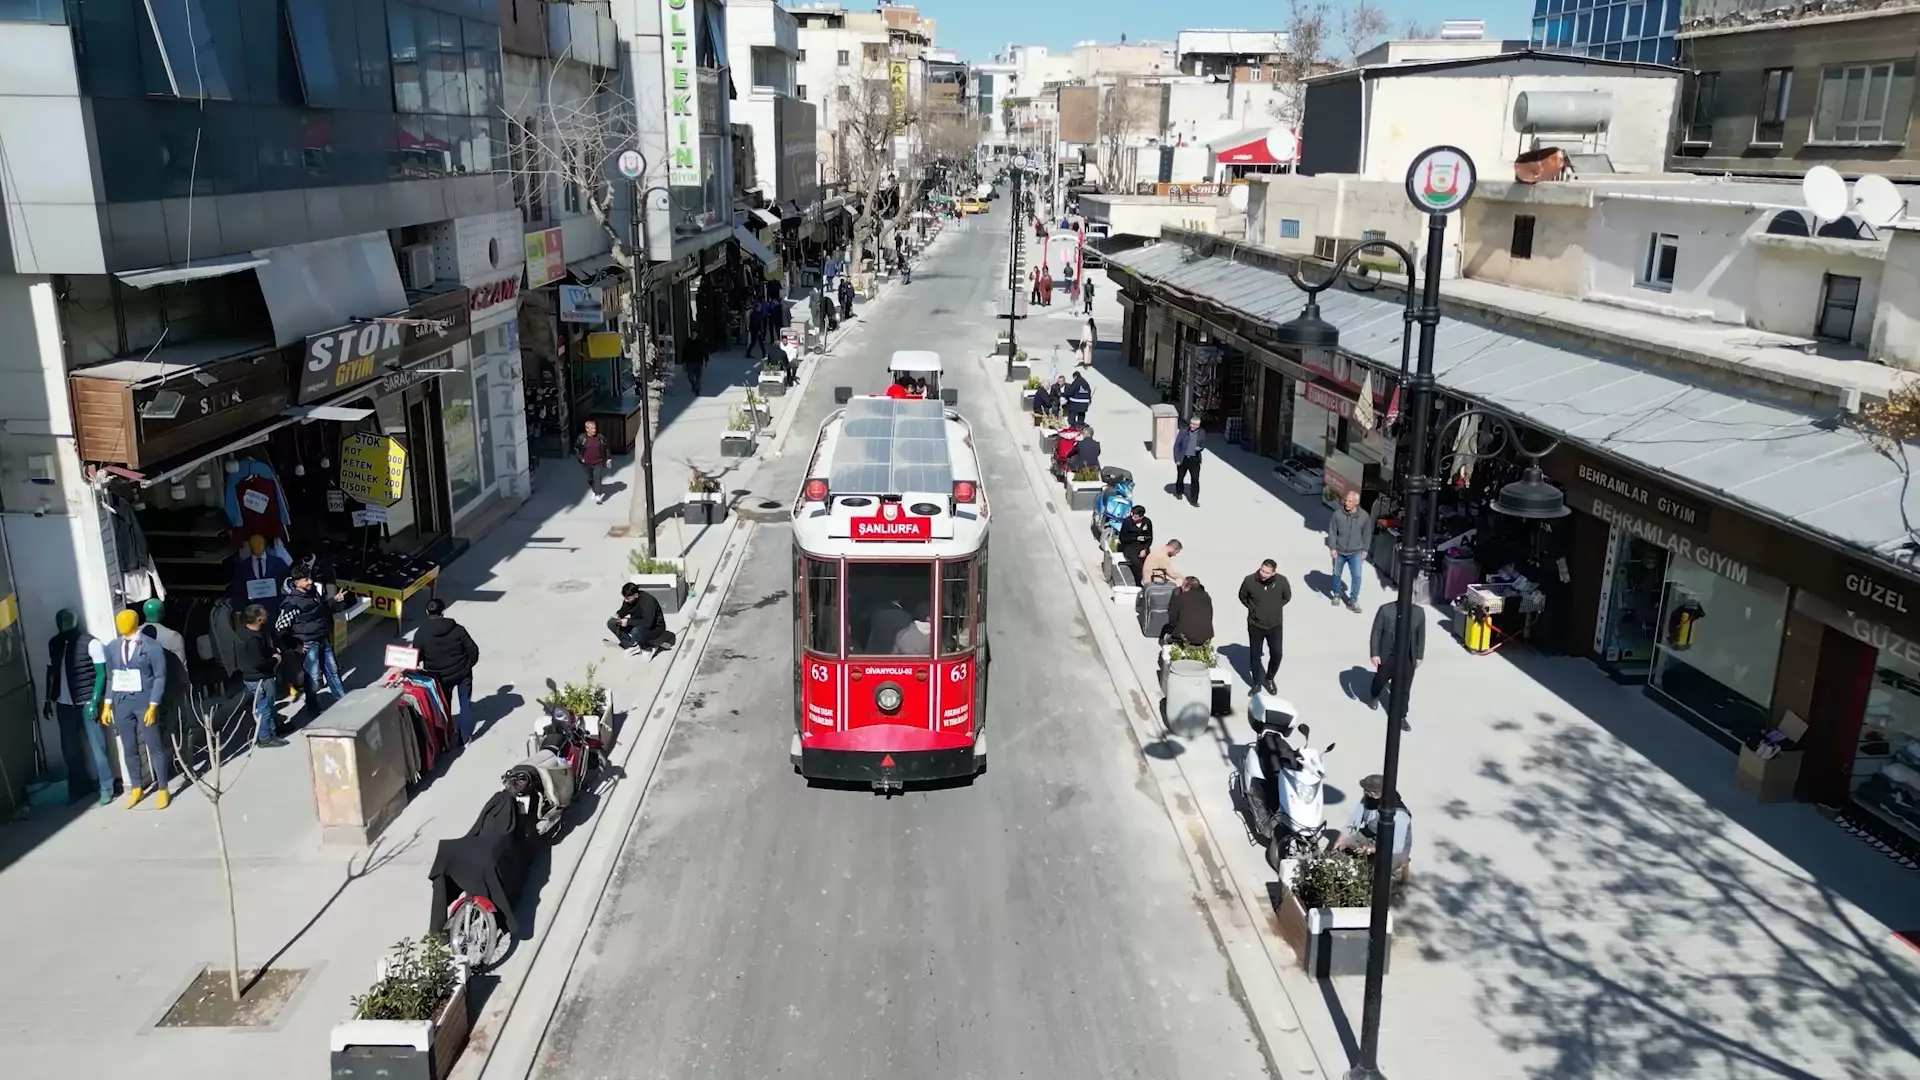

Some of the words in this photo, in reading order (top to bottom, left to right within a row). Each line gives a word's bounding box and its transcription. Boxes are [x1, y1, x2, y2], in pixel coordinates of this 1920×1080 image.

[308, 322, 400, 372] STOK
[355, 433, 380, 447] STOK
[344, 446, 362, 455] KOT
[343, 458, 372, 470] KETEN
[384, 479, 400, 488] 200
[1578, 464, 1648, 504] BEHRAMLAR
[858, 523, 920, 535] ŞANLIURFA
[1592, 499, 1692, 559] BEHRAMLAR
[1845, 574, 1907, 613] GÜZEL
[811, 664, 828, 682] 63
[950, 663, 967, 682] 63
